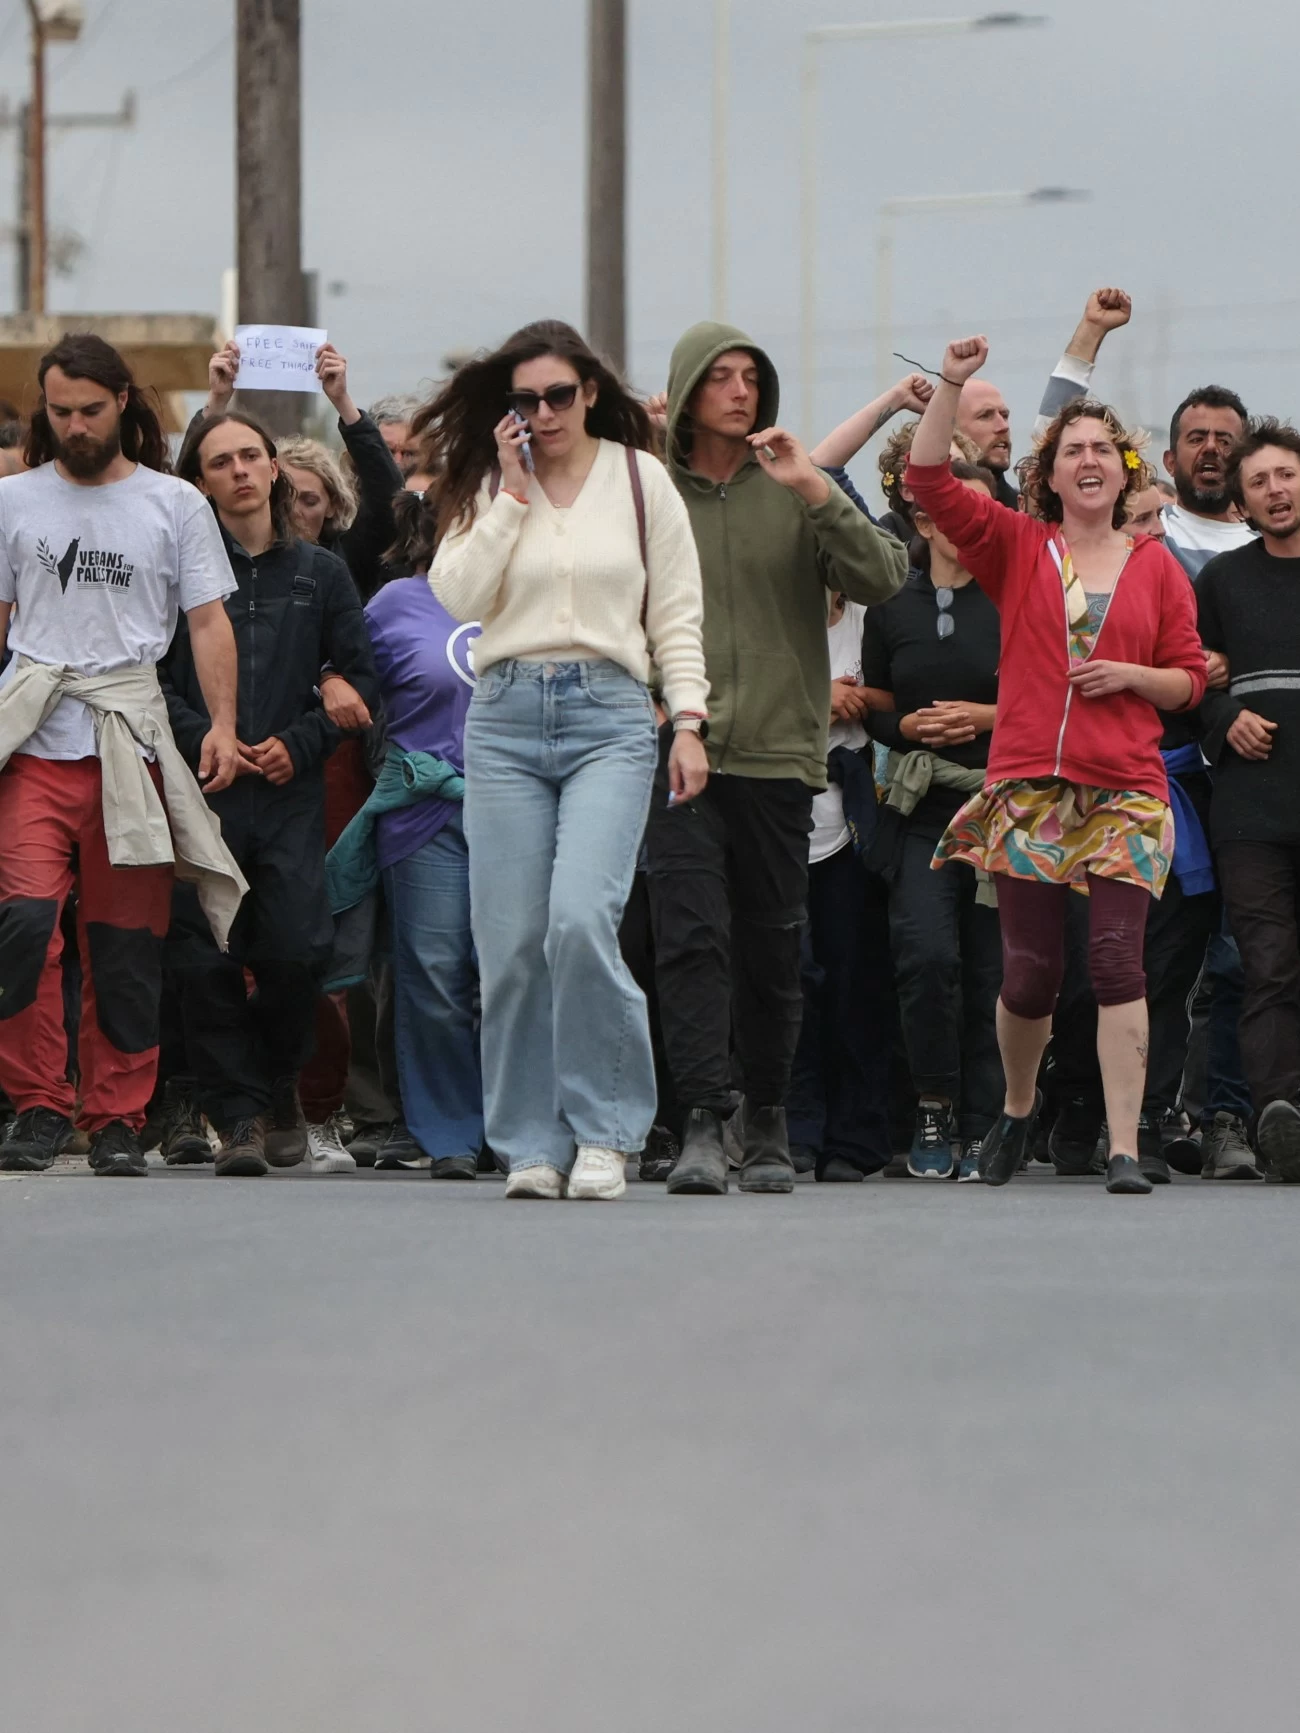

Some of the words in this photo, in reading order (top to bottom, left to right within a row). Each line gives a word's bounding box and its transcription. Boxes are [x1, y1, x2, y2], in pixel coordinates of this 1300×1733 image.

[246, 337, 283, 349] FREE
[240, 357, 272, 369] FREE
[280, 361, 314, 372] THIAGO
[79, 550, 124, 569] VEGANS
[123, 563, 135, 572] FOR
